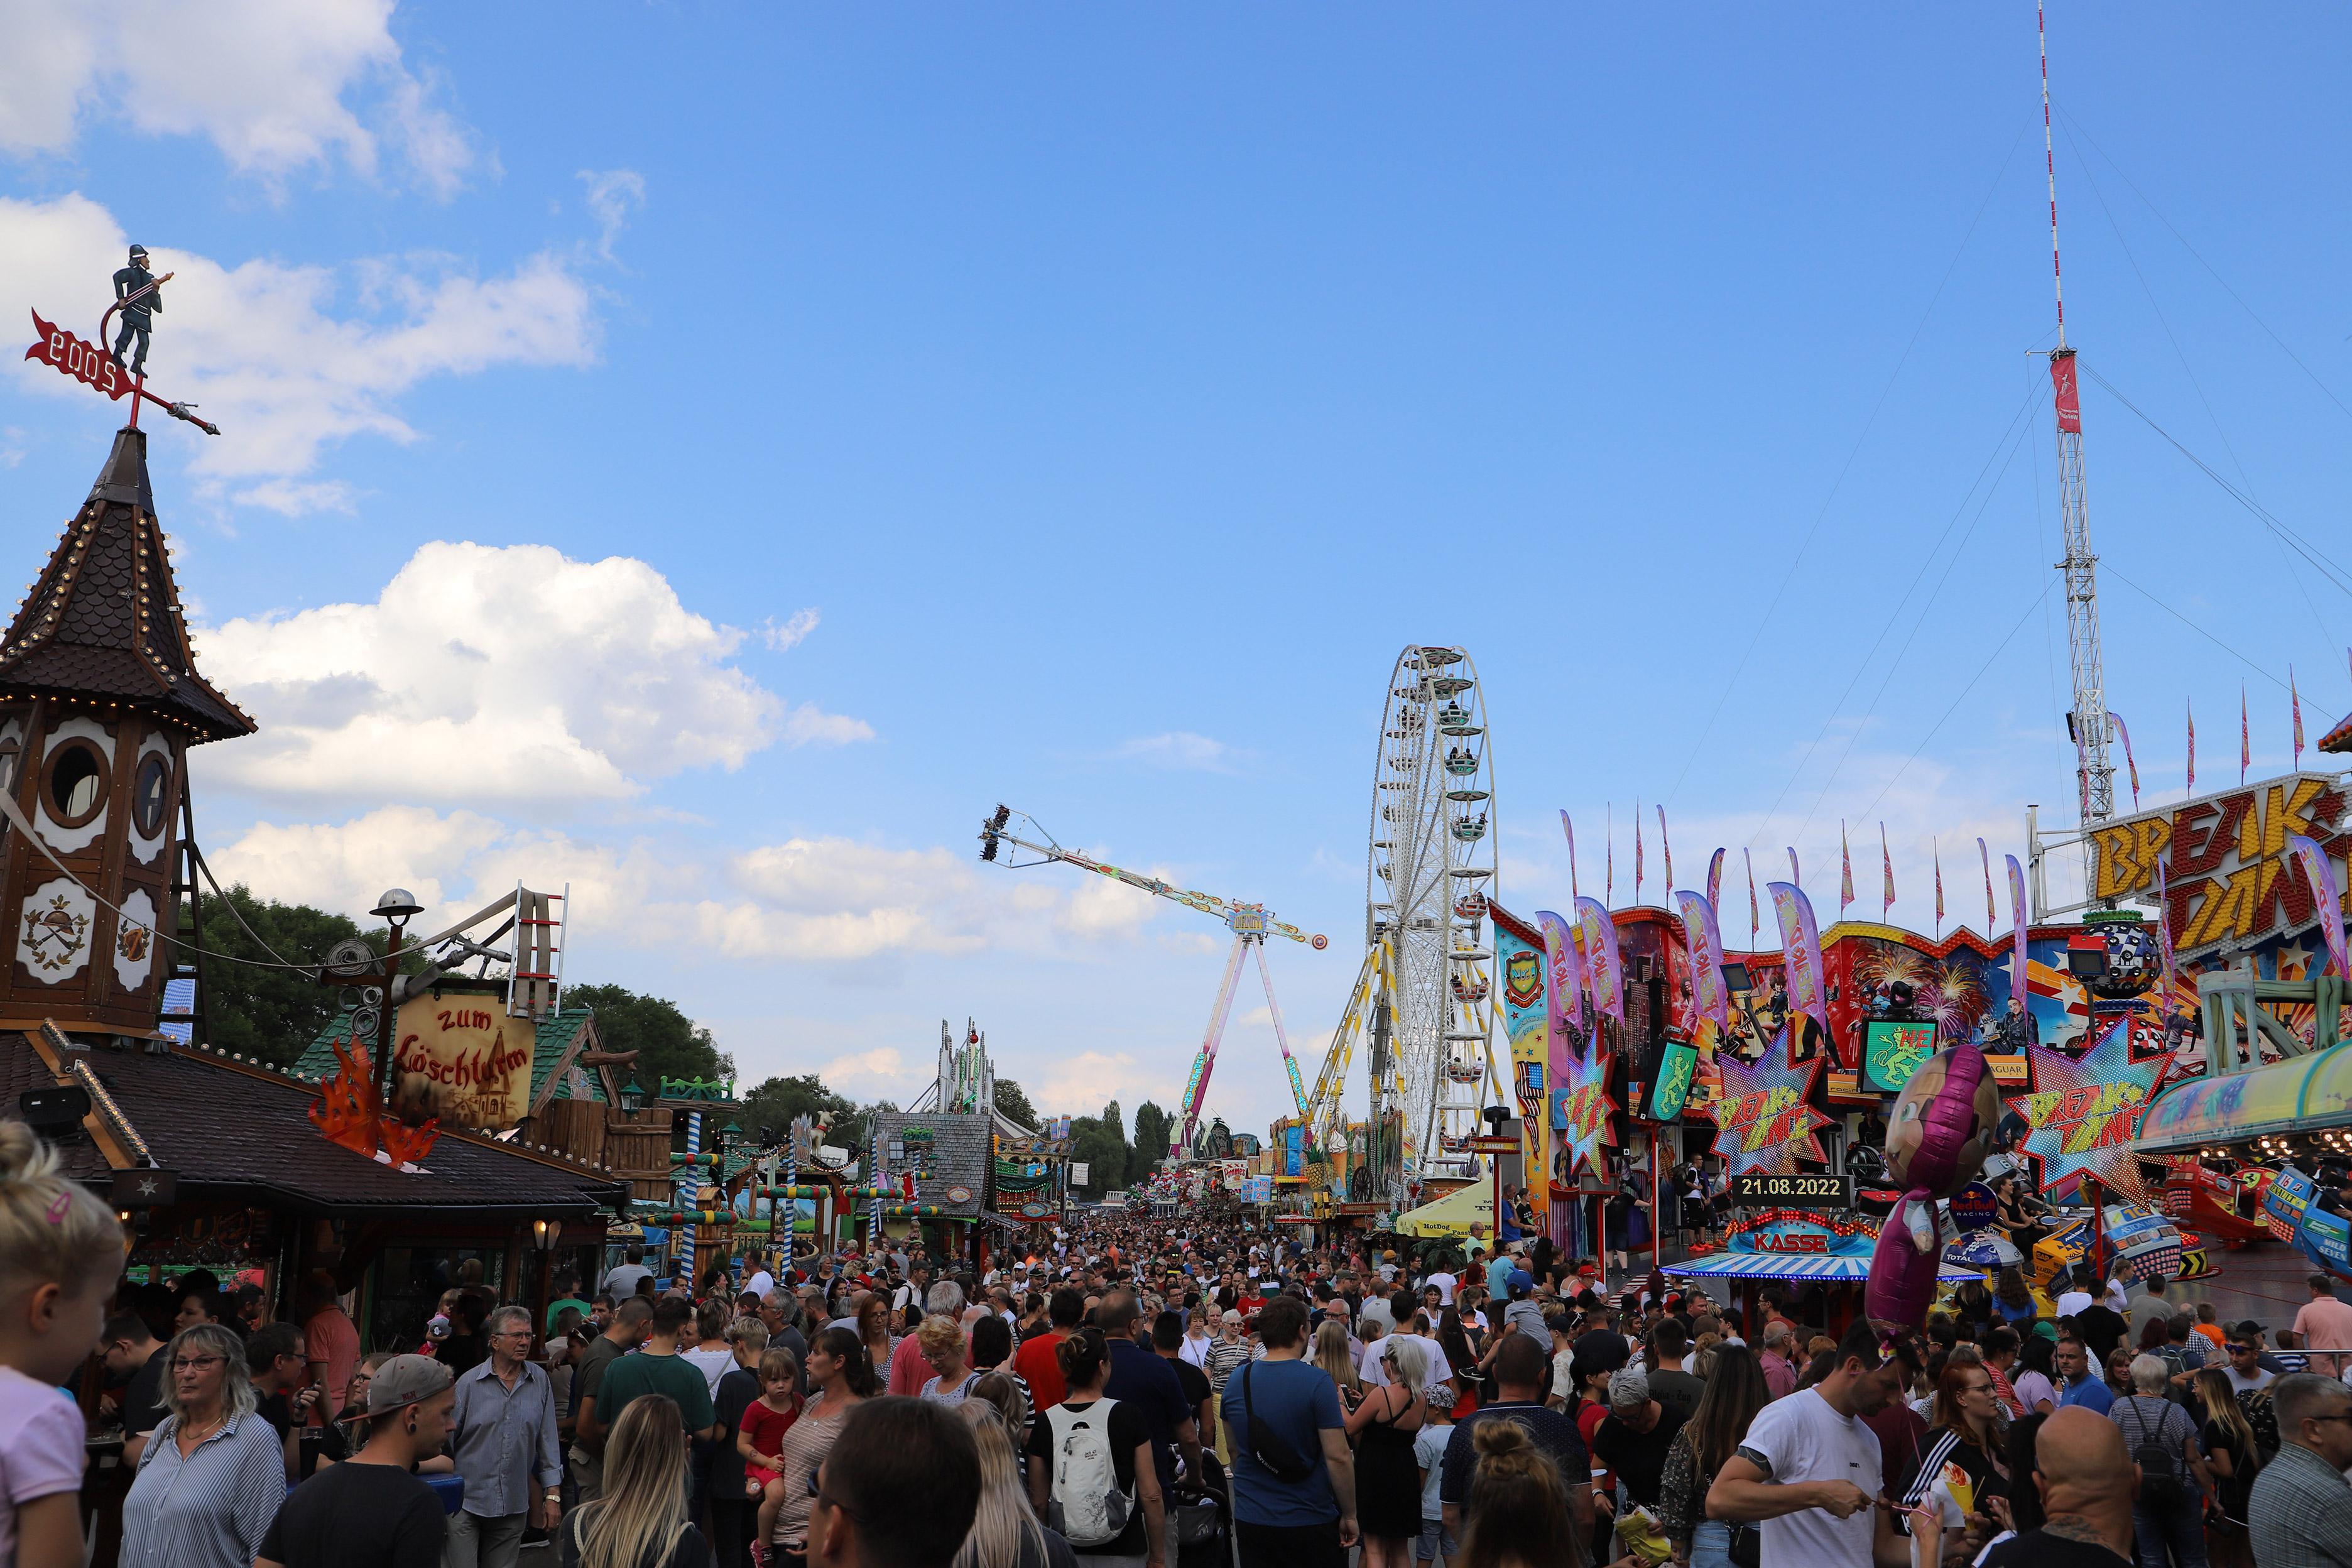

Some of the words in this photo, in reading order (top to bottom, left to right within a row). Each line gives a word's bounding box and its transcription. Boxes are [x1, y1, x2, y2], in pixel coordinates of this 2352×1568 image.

[2090, 778, 2333, 900] BREAK
[393, 1034, 528, 1089] Löschturm
[1716, 1086, 1792, 1131] BREAK
[2028, 1081, 2132, 1128] BREAK
[1736, 1105, 1809, 1153] DANCE
[2054, 1104, 2147, 1155] DANC
[1224, 1167, 1246, 1179] Pommes
[2281, 1174, 2290, 1187] 16
[1741, 1178, 1841, 1195] 21.08.2022
[2269, 1183, 2296, 1204] RENAULT
[1951, 1199, 1974, 1210] Red
[1974, 1199, 1995, 1210] Bull
[2121, 1223, 2145, 1234] ASTON
[1753, 1233, 1829, 1253] KASSE
[2324, 1239, 2347, 1251] MILD
[1946, 1254, 1973, 1262] TOTAL
[2036, 1253, 2050, 1261] SAP
[2319, 1246, 2347, 1261] SEVEN
[2036, 1266, 2056, 1275] LUBRA
[2050, 1275, 2069, 1290] CITRIX
